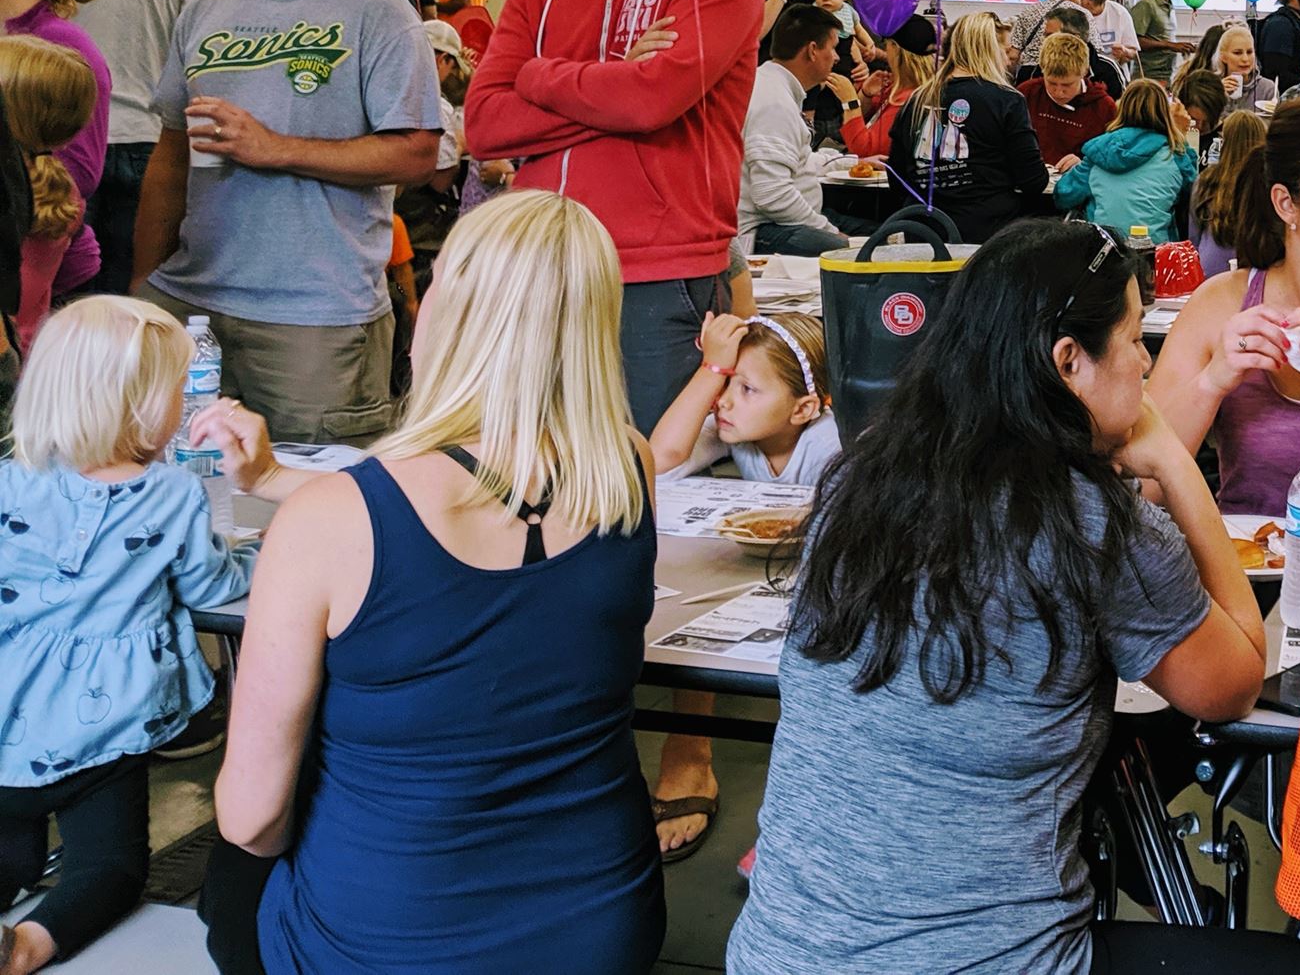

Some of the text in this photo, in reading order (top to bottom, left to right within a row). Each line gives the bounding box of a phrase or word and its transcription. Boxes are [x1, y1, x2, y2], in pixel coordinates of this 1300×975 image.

[234, 25, 279, 34] SEATTLE
[197, 20, 343, 69] Sonics
[288, 59, 332, 79] SONICS
